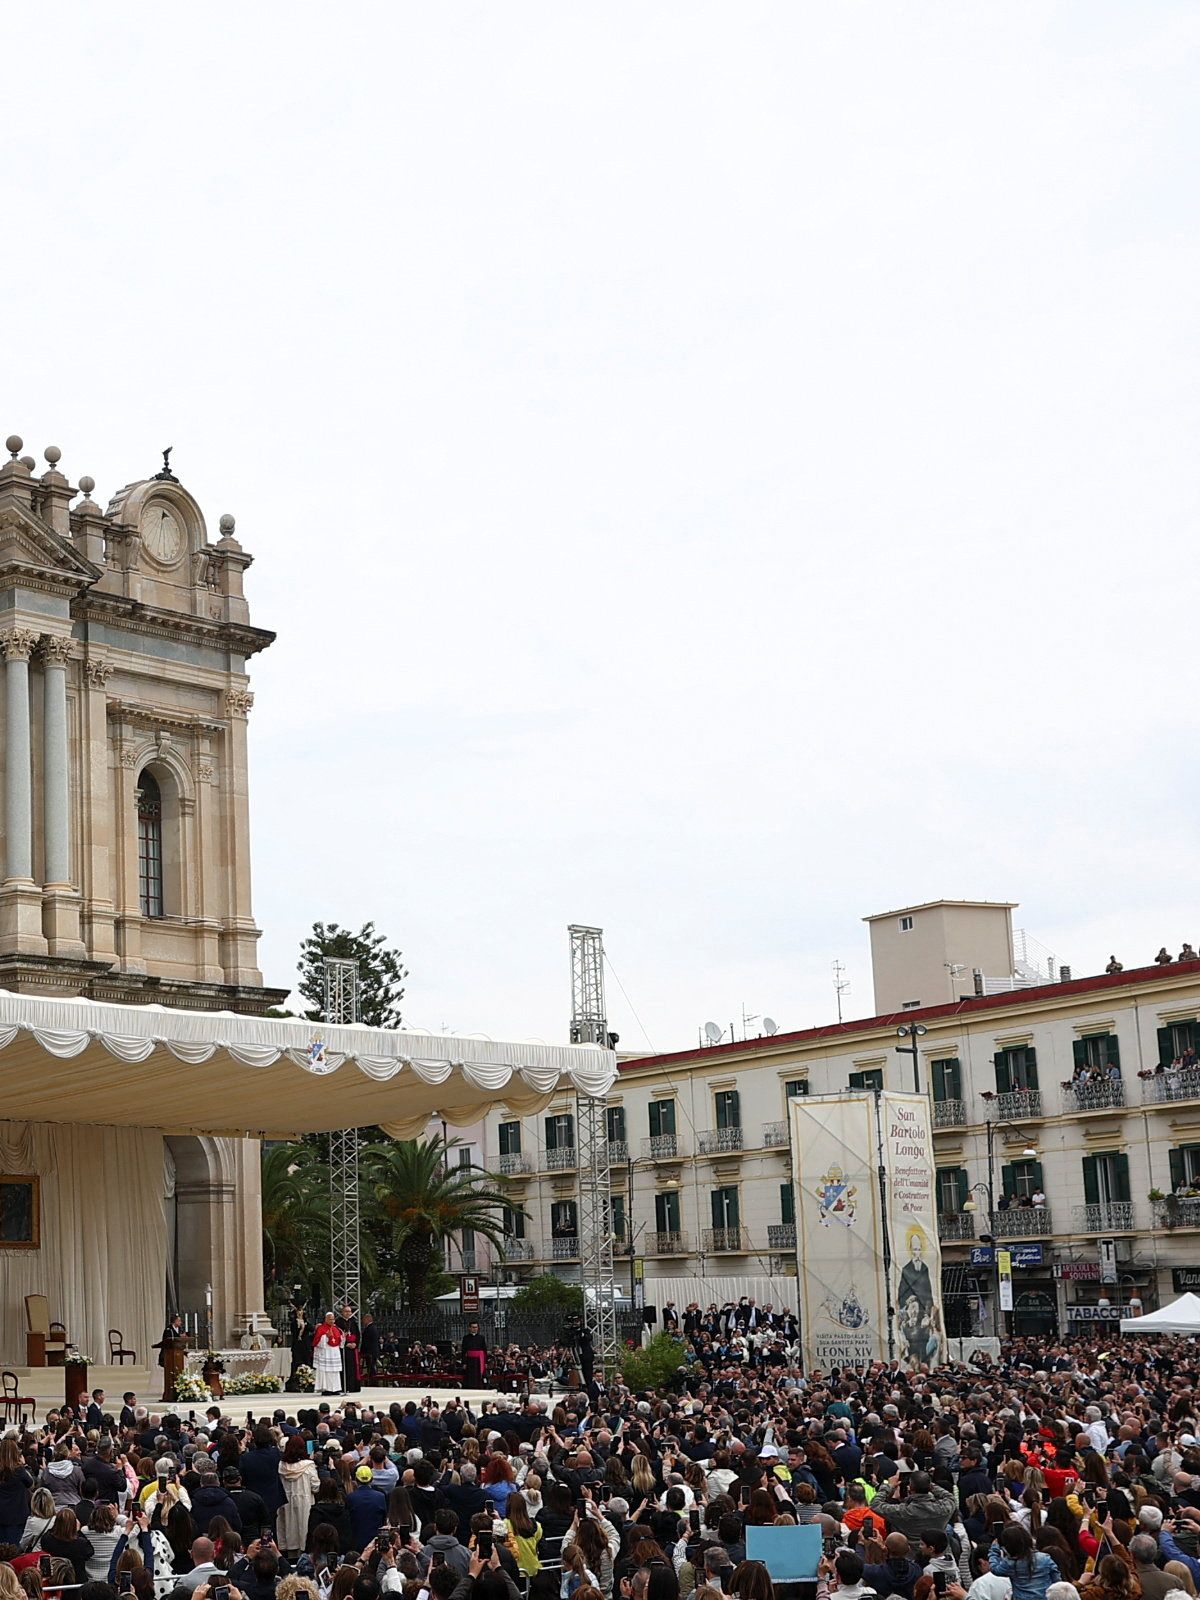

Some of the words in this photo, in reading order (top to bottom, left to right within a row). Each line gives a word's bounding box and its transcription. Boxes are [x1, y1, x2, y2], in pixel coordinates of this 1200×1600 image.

[897, 1107, 915, 1121] San
[890, 1124, 926, 1140] Bartolo
[895, 1142, 924, 1159] Longo
[1102, 1241, 1113, 1260] T
[1062, 1264, 1090, 1272] ARTICOLI
[1066, 1307, 1133, 1319] TABACCHI
[816, 1347, 851, 1357] LEONE
[855, 1347, 872, 1357] XIV
[820, 1359, 827, 1368] A
